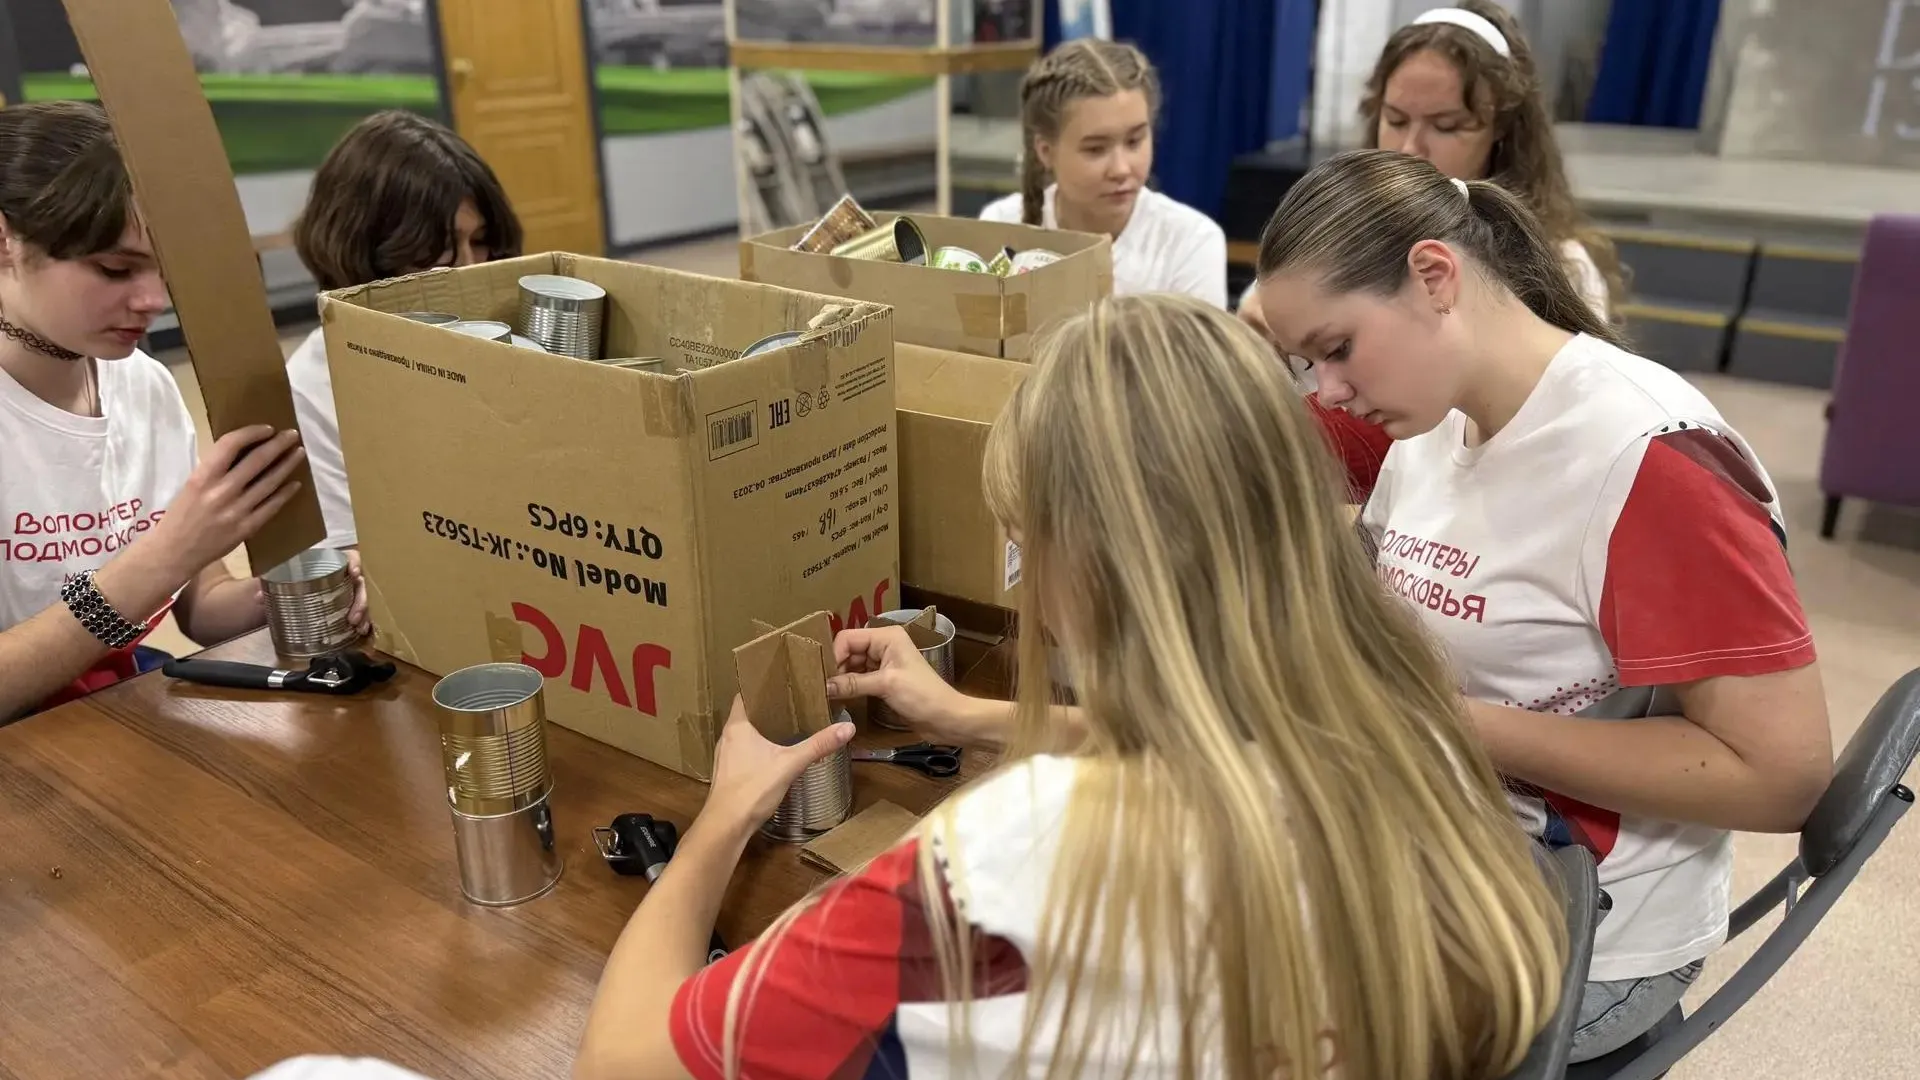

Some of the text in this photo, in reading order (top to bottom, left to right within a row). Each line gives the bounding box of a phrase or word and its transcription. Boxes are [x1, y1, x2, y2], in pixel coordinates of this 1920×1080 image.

[369, 349, 410, 368] Произведено
[416, 362, 436, 375] CHINA
[438, 368, 445, 378] IN
[446, 370, 466, 384] MADE
[769, 399, 790, 430] EAC
[857, 423, 886, 445] Production
[822, 448, 837, 462] Дата
[843, 440, 856, 452] date
[768, 456, 820, 484] производства:
[843, 455, 866, 472] Размер:
[869, 464, 887, 479] Weight
[733, 480, 765, 499] 04.2023
[528, 503, 663, 559] QTY: 6PCS
[831, 527, 846, 541] 6PCS
[862, 532, 871, 542] No.
[872, 524, 888, 538] Model
[422, 511, 667, 607] Model No.: JK-TS623
[832, 542, 856, 560] Модель:
[1381, 529, 1481, 579] ОЛОНТЕРЫ
[803, 556, 831, 578] JK-TS623
[1380, 563, 1487, 623] МОСКОВЬЯ
[511, 602, 671, 718] JVC
